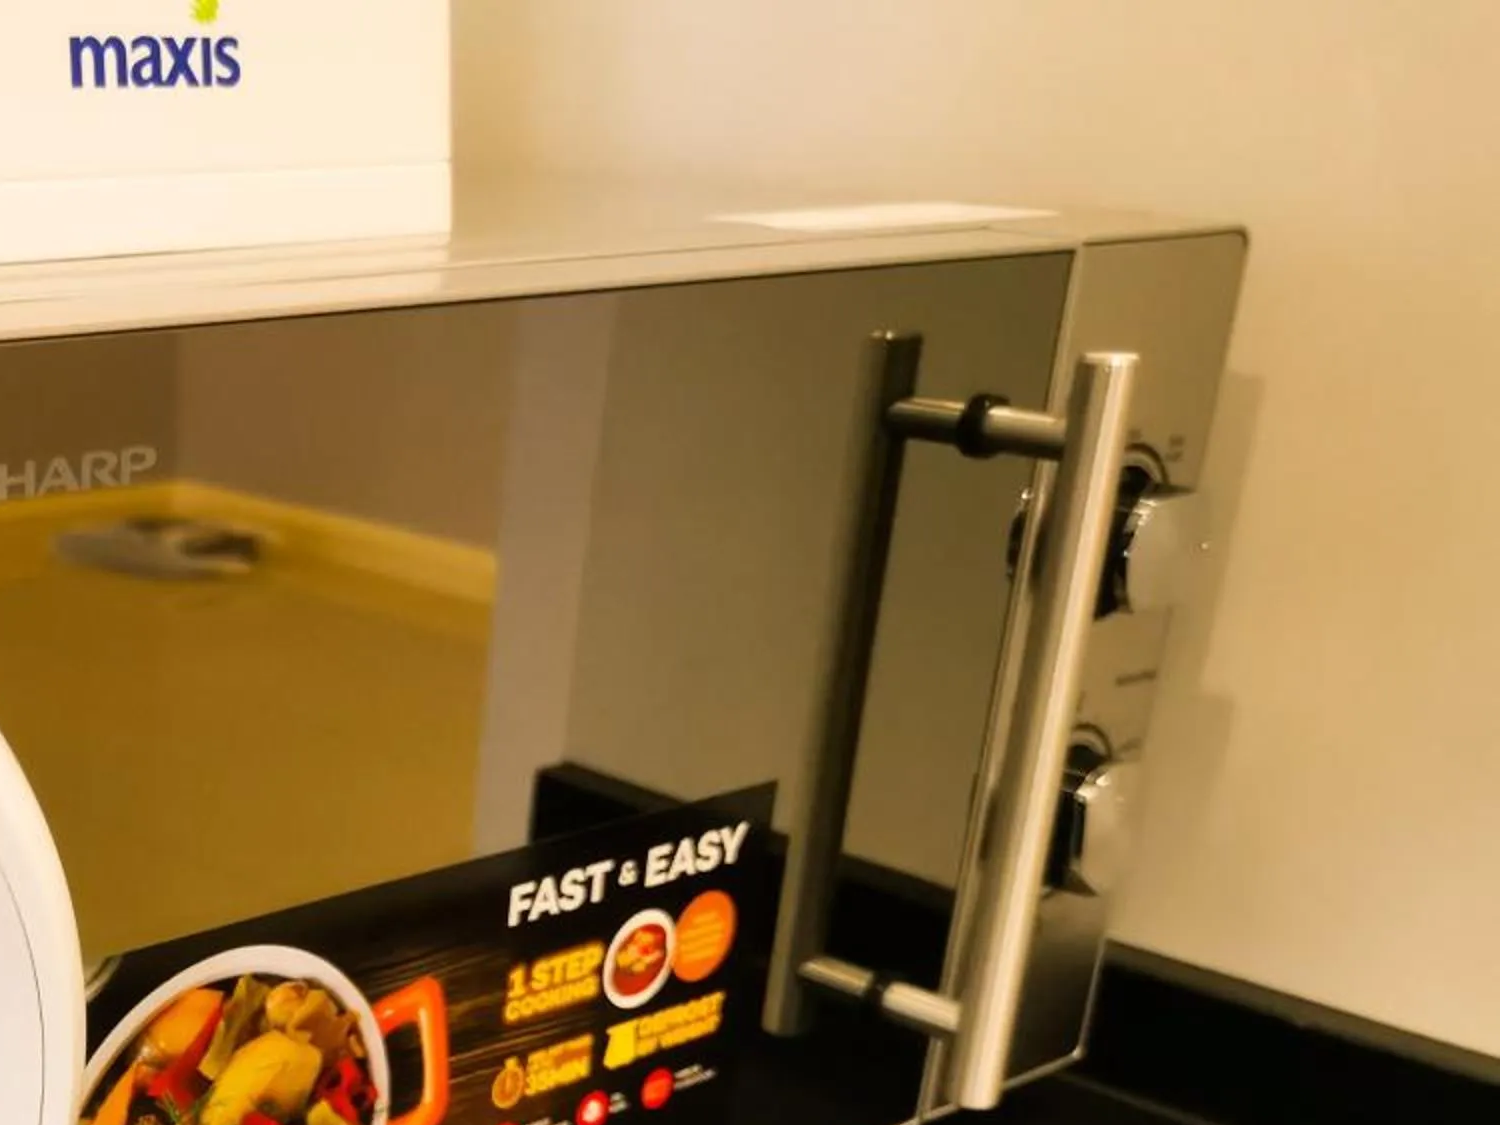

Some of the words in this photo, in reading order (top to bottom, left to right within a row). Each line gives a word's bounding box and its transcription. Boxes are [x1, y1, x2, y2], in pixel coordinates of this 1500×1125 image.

[70, 34, 241, 88] maxis
[508, 858, 614, 927] FAST
[618, 859, 639, 886] &
[644, 820, 749, 889] EASY
[507, 963, 526, 999] 1
[531, 940, 604, 991] STEP
